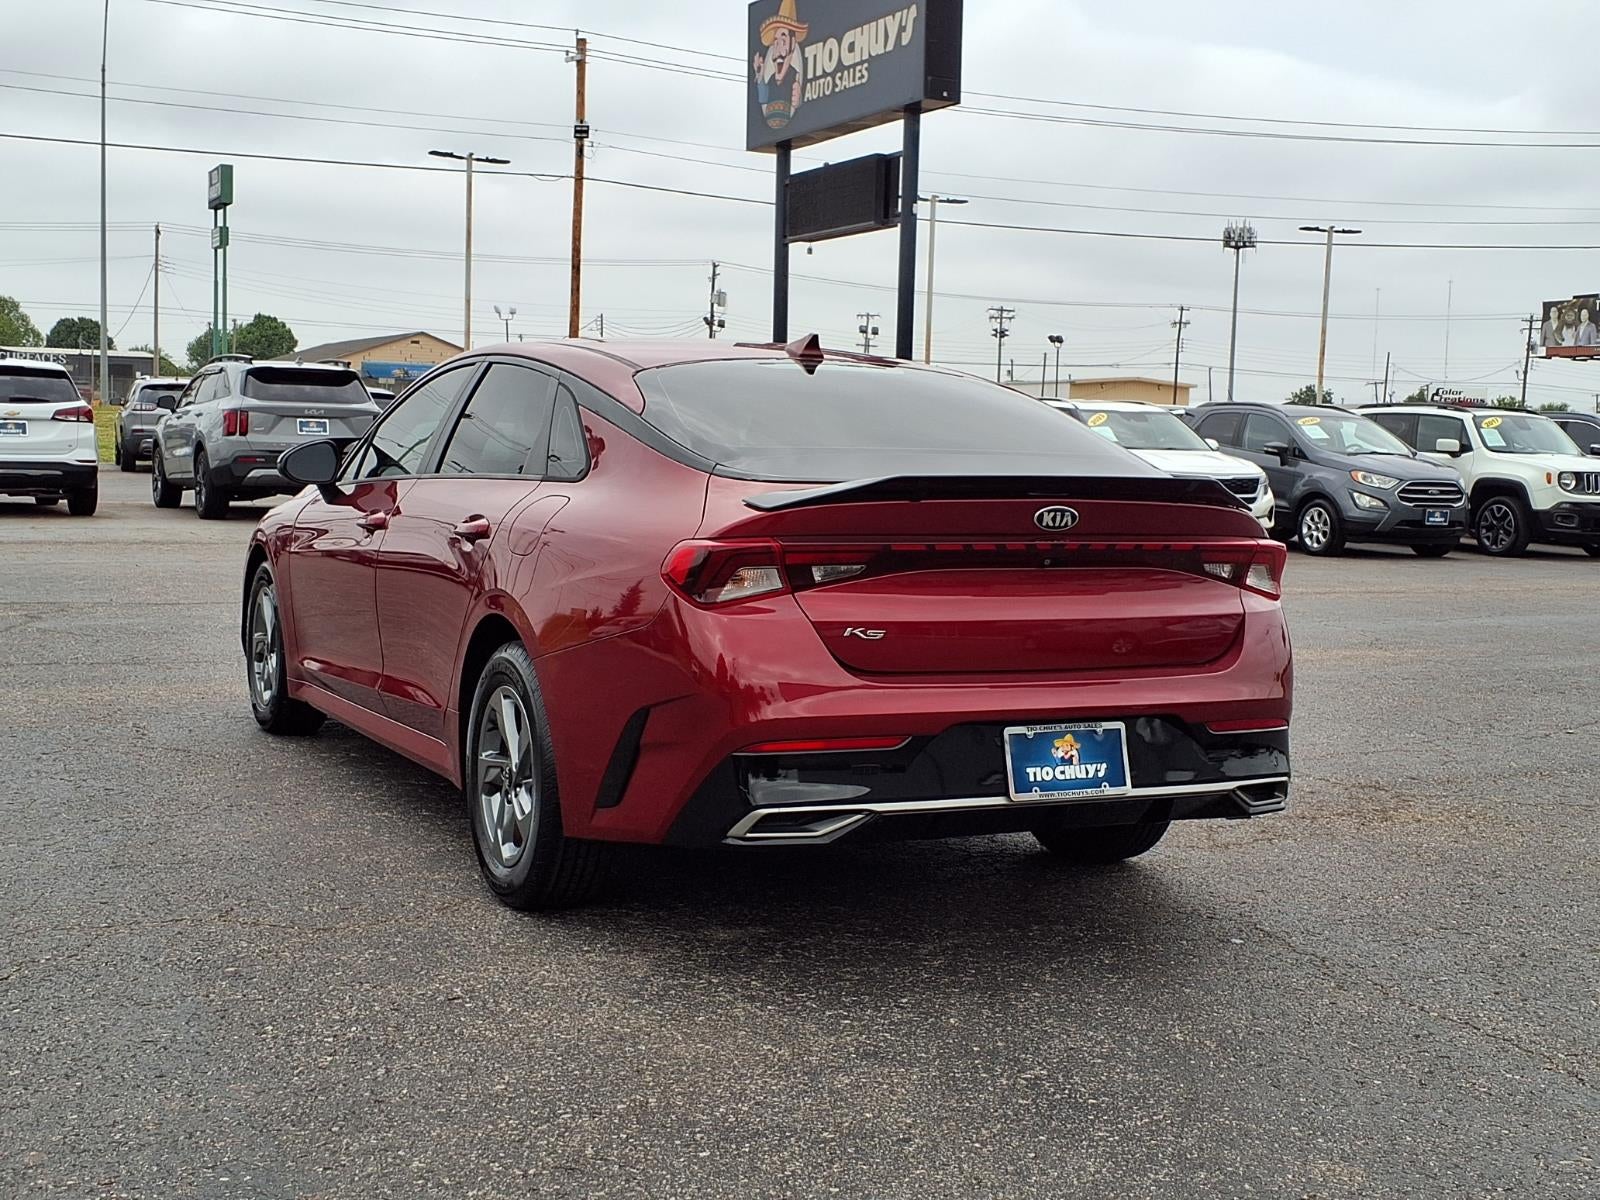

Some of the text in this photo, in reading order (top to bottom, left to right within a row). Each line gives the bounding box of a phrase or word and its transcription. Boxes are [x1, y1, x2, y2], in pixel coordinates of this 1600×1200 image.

[804, 4, 917, 79] TIO CHUY'S
[804, 62, 869, 102] AUTO SALES
[1436, 387, 1464, 396] Color
[1042, 511, 1072, 527] KIA
[843, 627, 886, 640] K5
[1026, 763, 1107, 782] TIO CHUY'S
[1039, 789, 1105, 799] WWW.TIOCHUYS.COM
